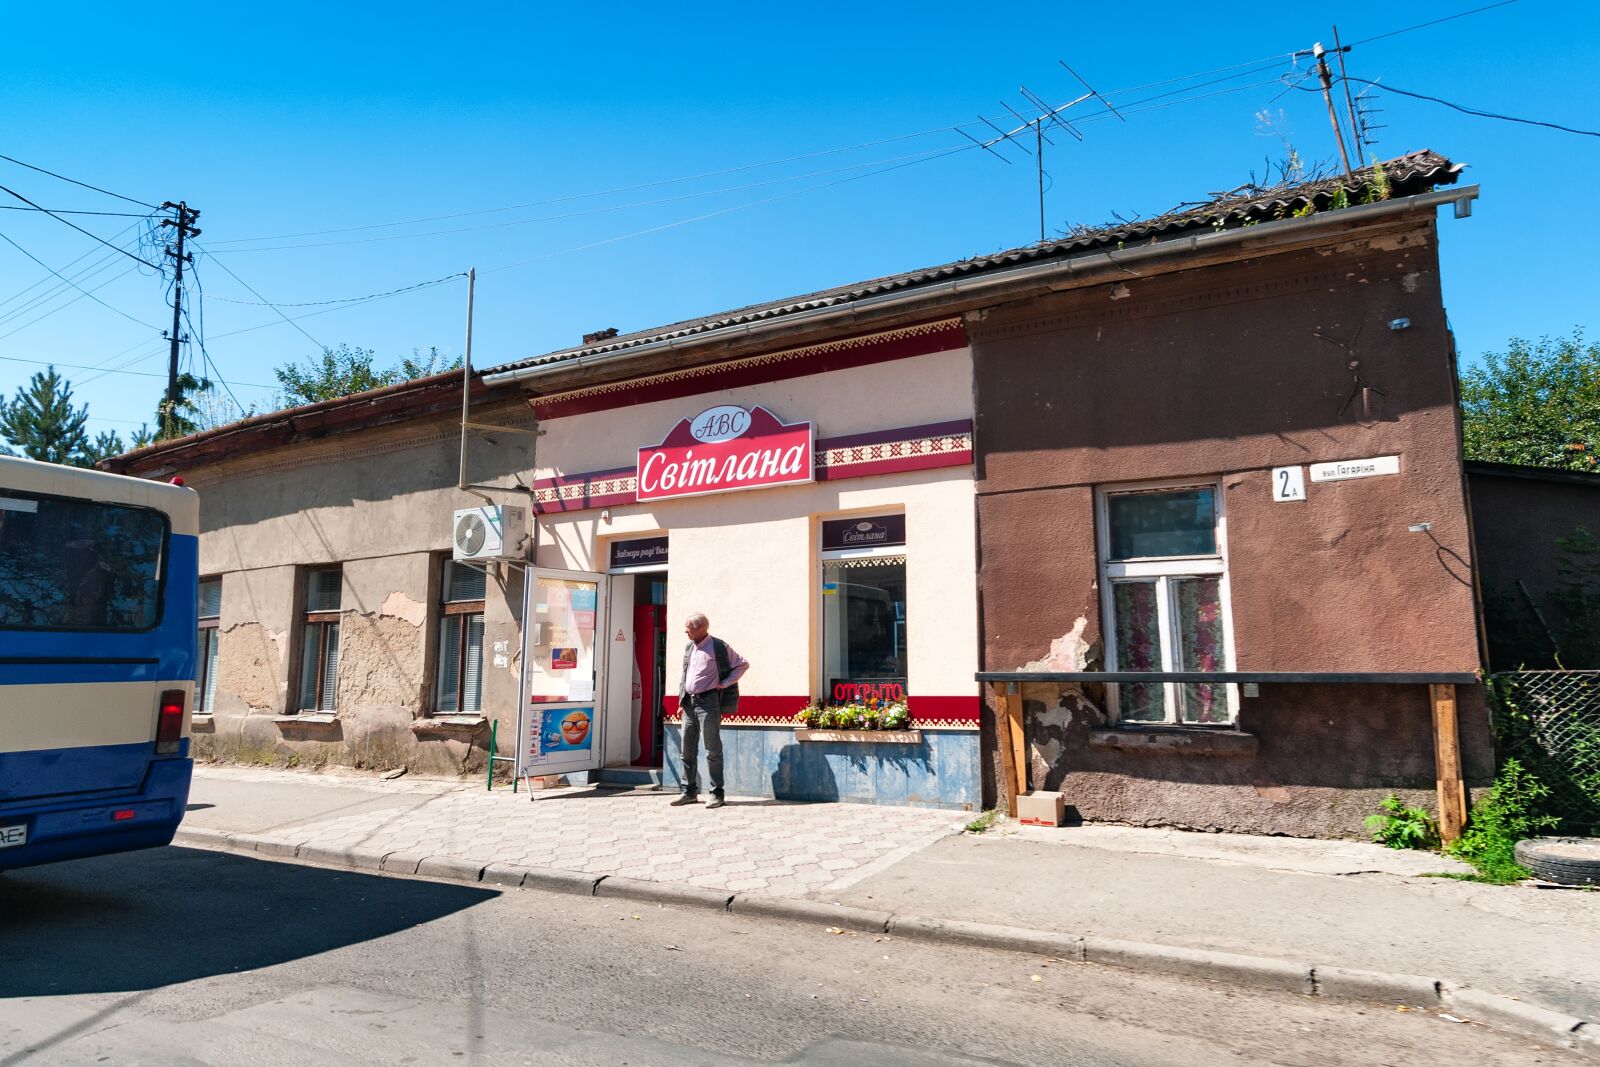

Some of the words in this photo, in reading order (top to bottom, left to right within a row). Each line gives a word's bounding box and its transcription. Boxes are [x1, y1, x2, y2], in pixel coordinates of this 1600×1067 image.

[641, 442, 806, 493] Світлана
[1337, 464, 1375, 476] Гагаріна
[844, 531, 885, 542] Світлана
[834, 683, 903, 701] ОТКРЫТО
